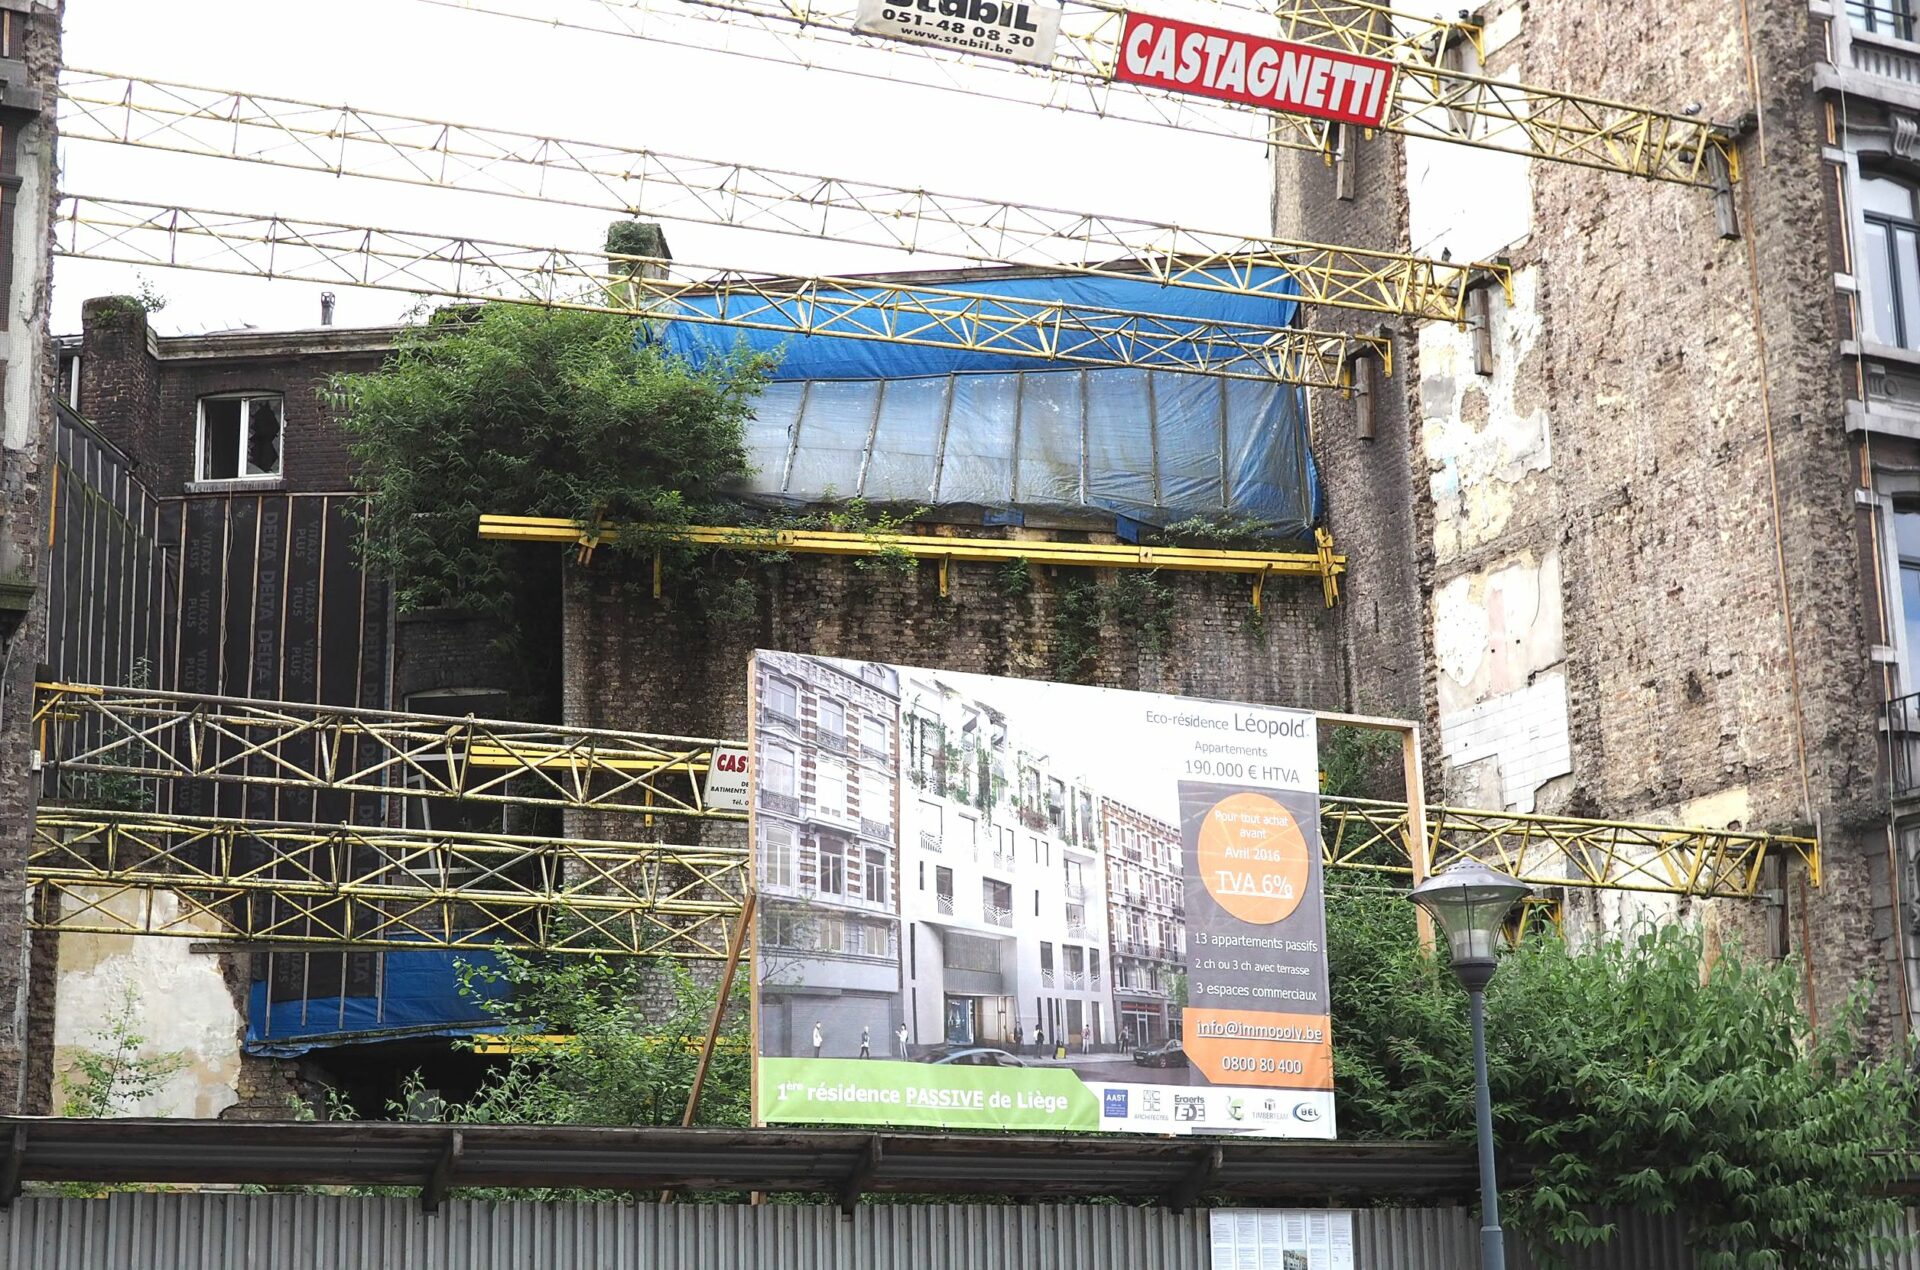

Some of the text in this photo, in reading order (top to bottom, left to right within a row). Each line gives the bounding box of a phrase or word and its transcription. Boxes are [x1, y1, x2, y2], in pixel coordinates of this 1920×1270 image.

[882, 9, 1035, 48] 051-48 08 30
[901, 27, 1014, 55] www.stabil.be
[1125, 22, 1386, 118] CASTAGNETTI
[261, 511, 278, 562] DELTA
[295, 528, 306, 558] PLUS
[306, 520, 319, 566] VITAXX
[190, 539, 200, 569] PLUS
[200, 530, 212, 576] VITAXX
[259, 570, 276, 621] DELTA
[293, 586, 304, 617] PLUS
[304, 579, 316, 624] VITAXX
[187, 598, 198, 628] PLUS
[198, 590, 210, 635] VITAXX
[256, 630, 273, 680] DELTA
[291, 647, 301, 677] PLUS
[302, 638, 314, 684] VITAXX
[363, 622, 380, 675] DELTA
[184, 657, 195, 687] PLUS
[1146, 710, 1229, 731] Eco-résidence
[1195, 740, 1268, 758] Appartements
[1185, 759, 1300, 784] 190.000 € HTVA
[710, 786, 747, 795] BATIMENTS
[1215, 809, 1289, 827] Pour tout achat
[1239, 827, 1267, 840] avant
[1224, 846, 1281, 863] Avril 2016
[1215, 870, 1294, 898] TVA 6%
[1195, 932, 1319, 953] 13 appartements passifs
[1195, 958, 1311, 976] 2 ch ou 3 ch avec terrasse
[1196, 982, 1318, 1002] 3 espaces commerciaux
[1196, 1019, 1323, 1043] info@immopoly.be
[1222, 1055, 1303, 1075] 0800 80 400
[806, 1081, 901, 1104] résidence
[904, 1086, 984, 1109] PASSIVE
[988, 1090, 1012, 1109] de
[1016, 1090, 1069, 1114] Liège
[1106, 1094, 1127, 1103] AAST
